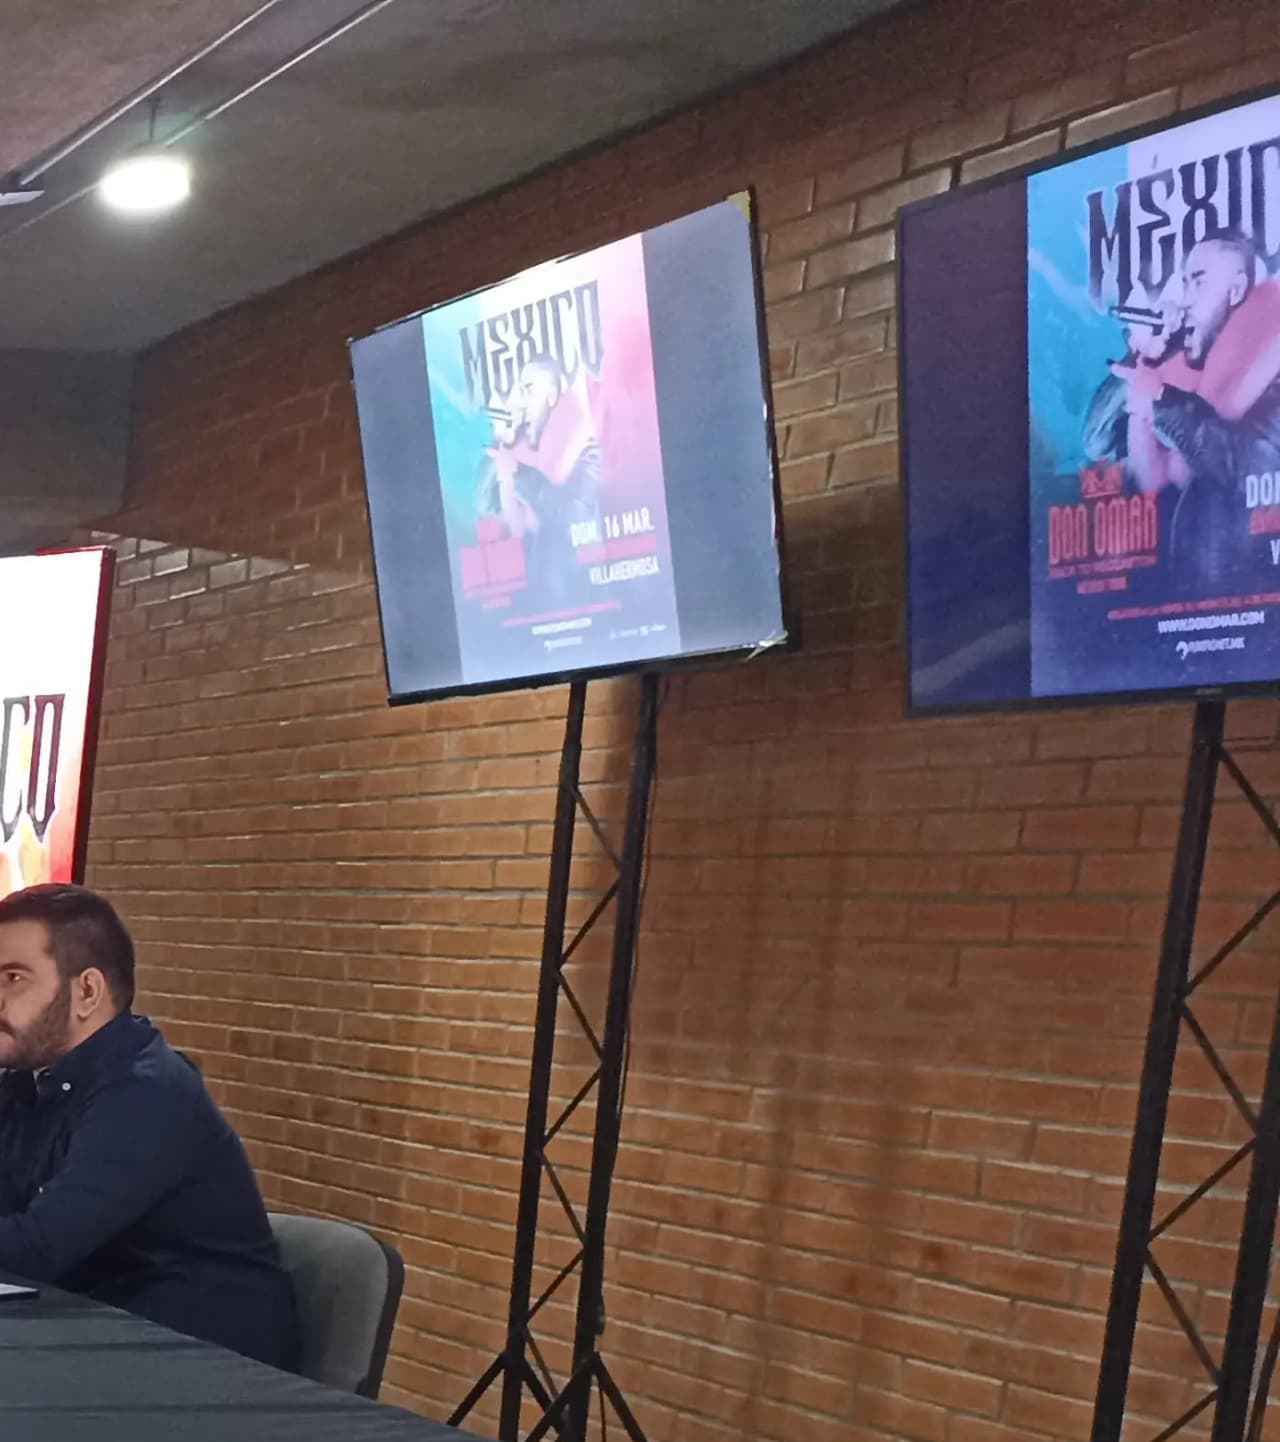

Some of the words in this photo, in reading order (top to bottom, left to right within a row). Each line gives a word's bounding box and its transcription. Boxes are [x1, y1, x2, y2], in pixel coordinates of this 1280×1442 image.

[459, 280, 604, 408] MEXICO
[604, 516, 619, 539] 16
[1048, 504, 1088, 565] DON
